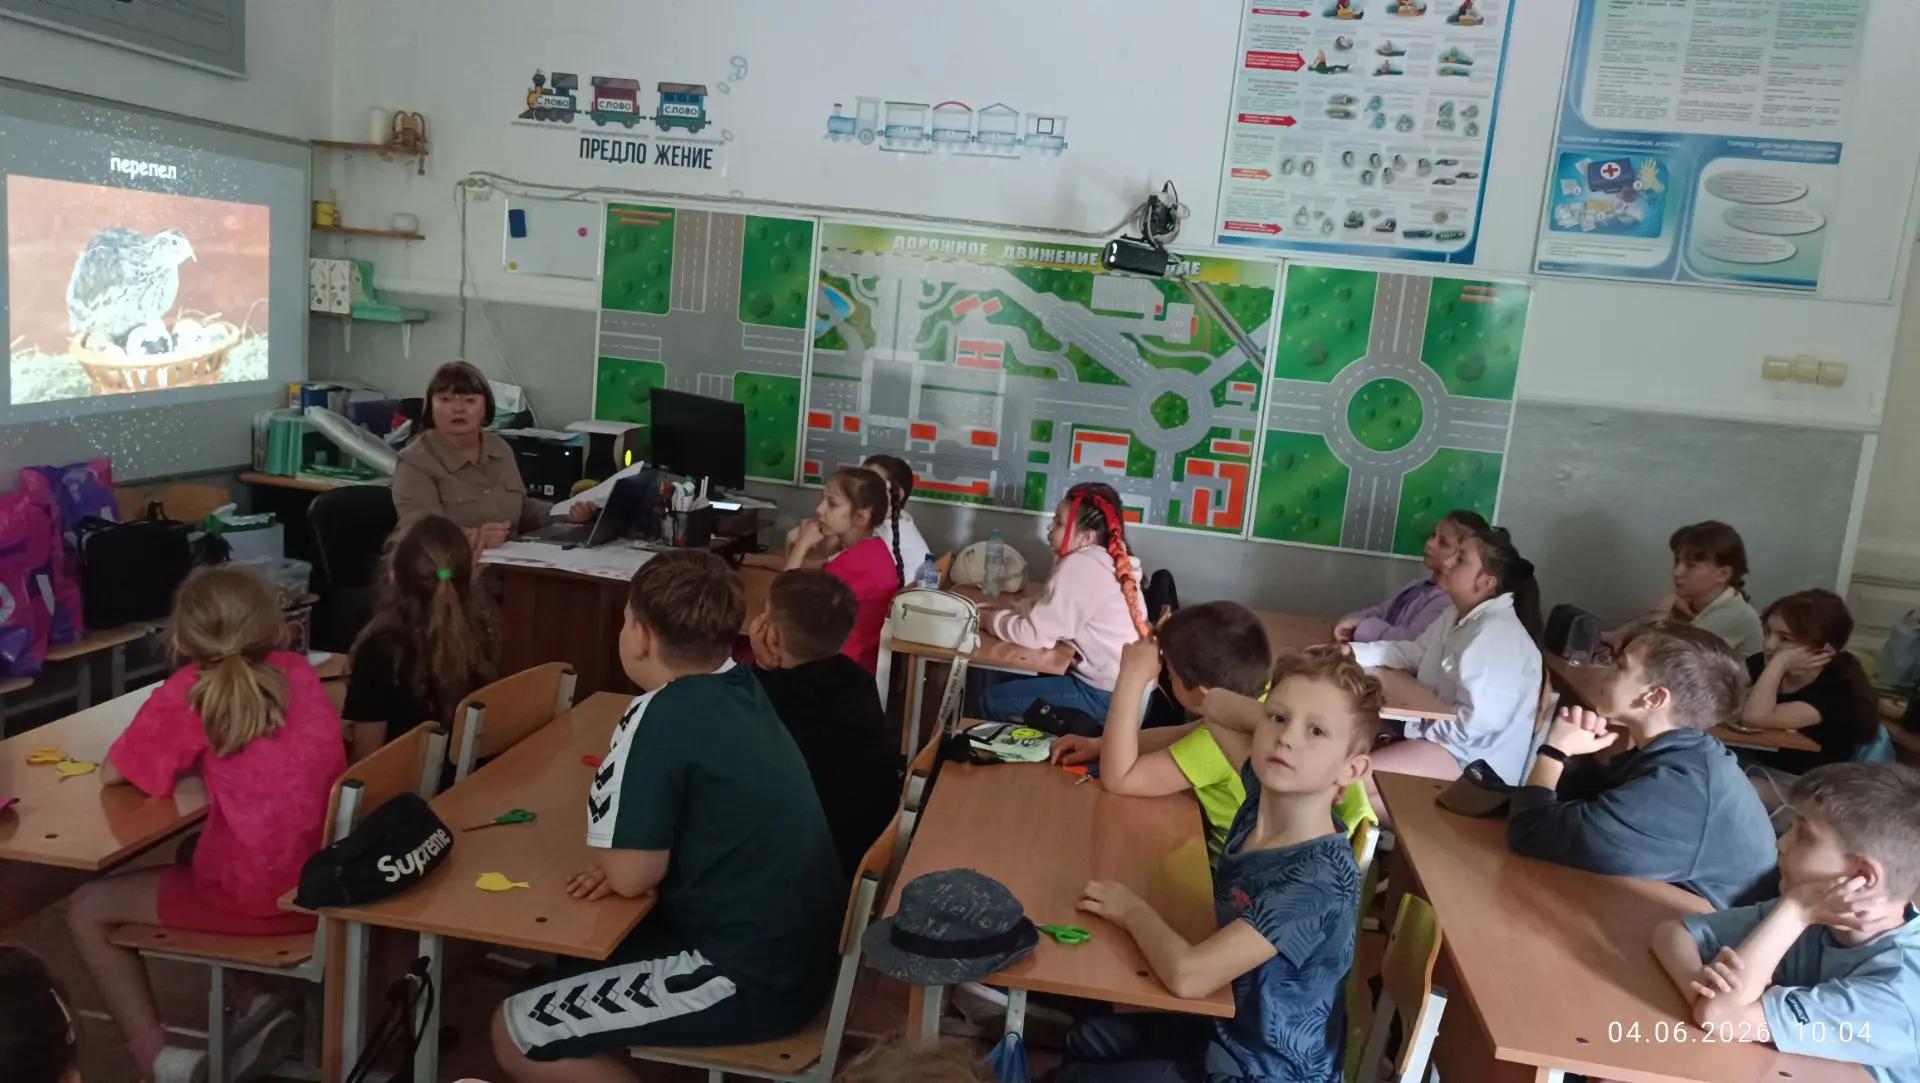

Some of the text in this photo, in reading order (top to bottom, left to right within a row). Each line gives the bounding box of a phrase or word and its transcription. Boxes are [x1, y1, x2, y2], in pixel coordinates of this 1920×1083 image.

[599, 100, 632, 111] слово
[664, 106, 698, 116] слово
[579, 137, 713, 170] ПРЕДЛО ЖЕНИЕ
[110, 156, 177, 180] перепел
[893, 234, 988, 257] ДОРОЖНОЕ
[1004, 244, 1099, 267] ДВИЖЕНИЕ
[376, 828, 451, 883] Supreme
